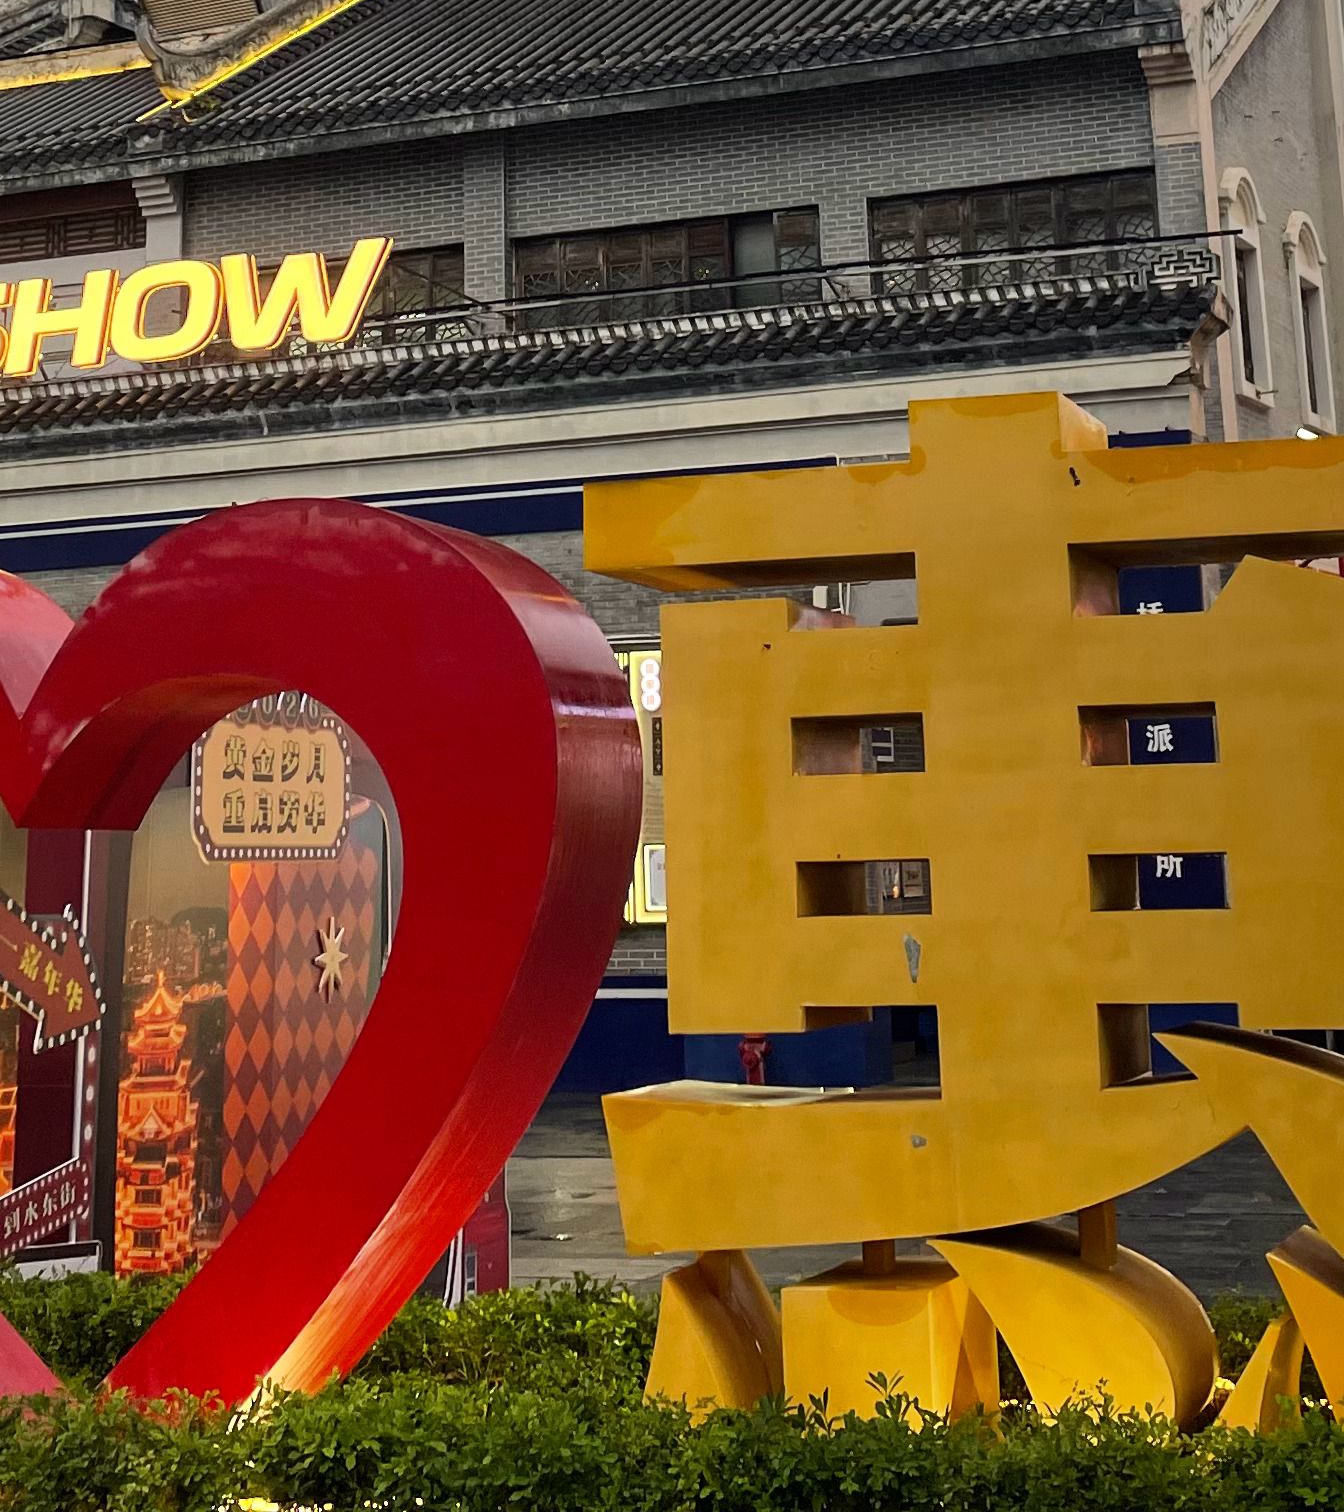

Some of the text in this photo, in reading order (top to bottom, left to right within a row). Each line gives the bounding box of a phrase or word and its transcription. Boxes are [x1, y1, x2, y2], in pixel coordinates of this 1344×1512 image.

[222, 735, 326, 784] 黄金岁月
[222, 788, 326, 834] 重启芳华
